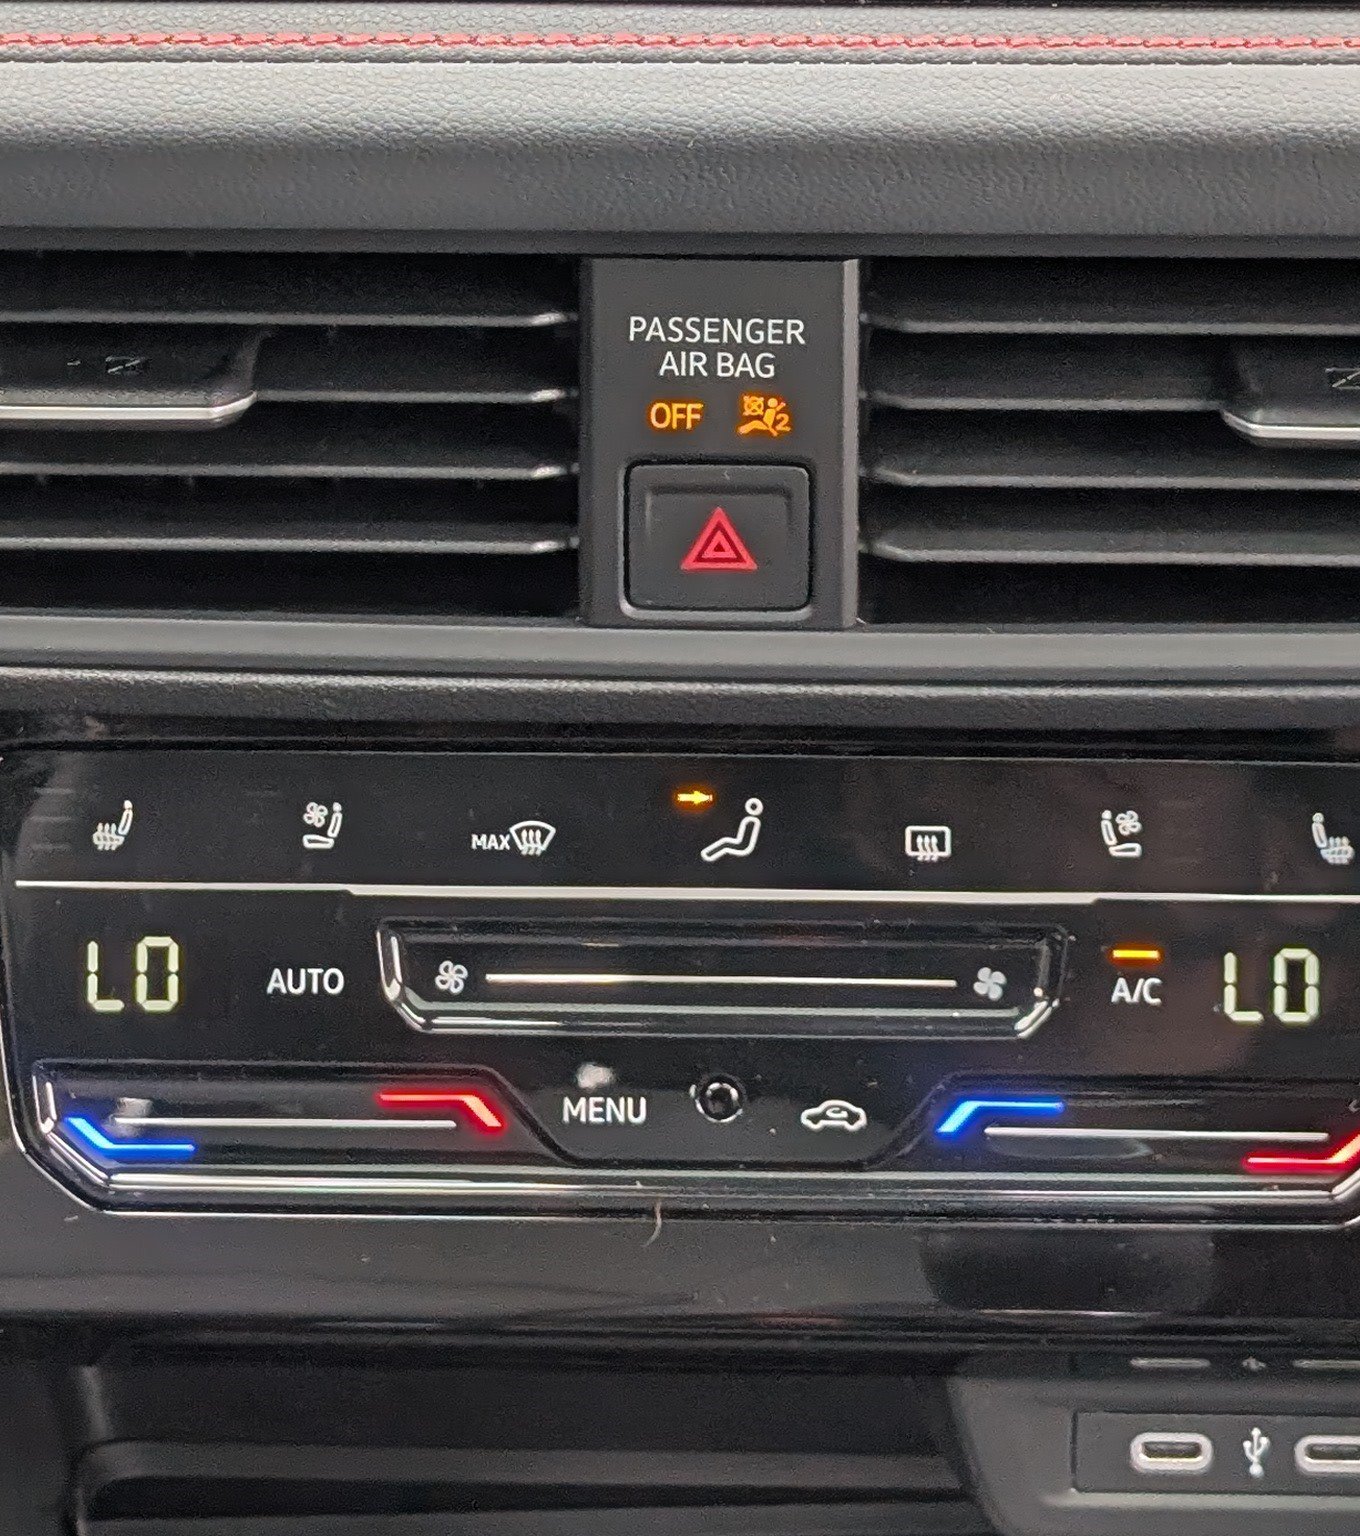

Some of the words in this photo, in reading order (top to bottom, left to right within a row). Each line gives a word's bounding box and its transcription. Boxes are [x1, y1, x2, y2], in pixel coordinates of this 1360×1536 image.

[629, 316, 806, 345] PASSENGER
[659, 350, 708, 377] AIR
[716, 351, 776, 379] BAG
[650, 402, 704, 430] OFF
[471, 833, 511, 851] MAX
[266, 967, 345, 995] AUTO
[1111, 977, 1162, 1006] A/C
[562, 1096, 647, 1124] MENU
